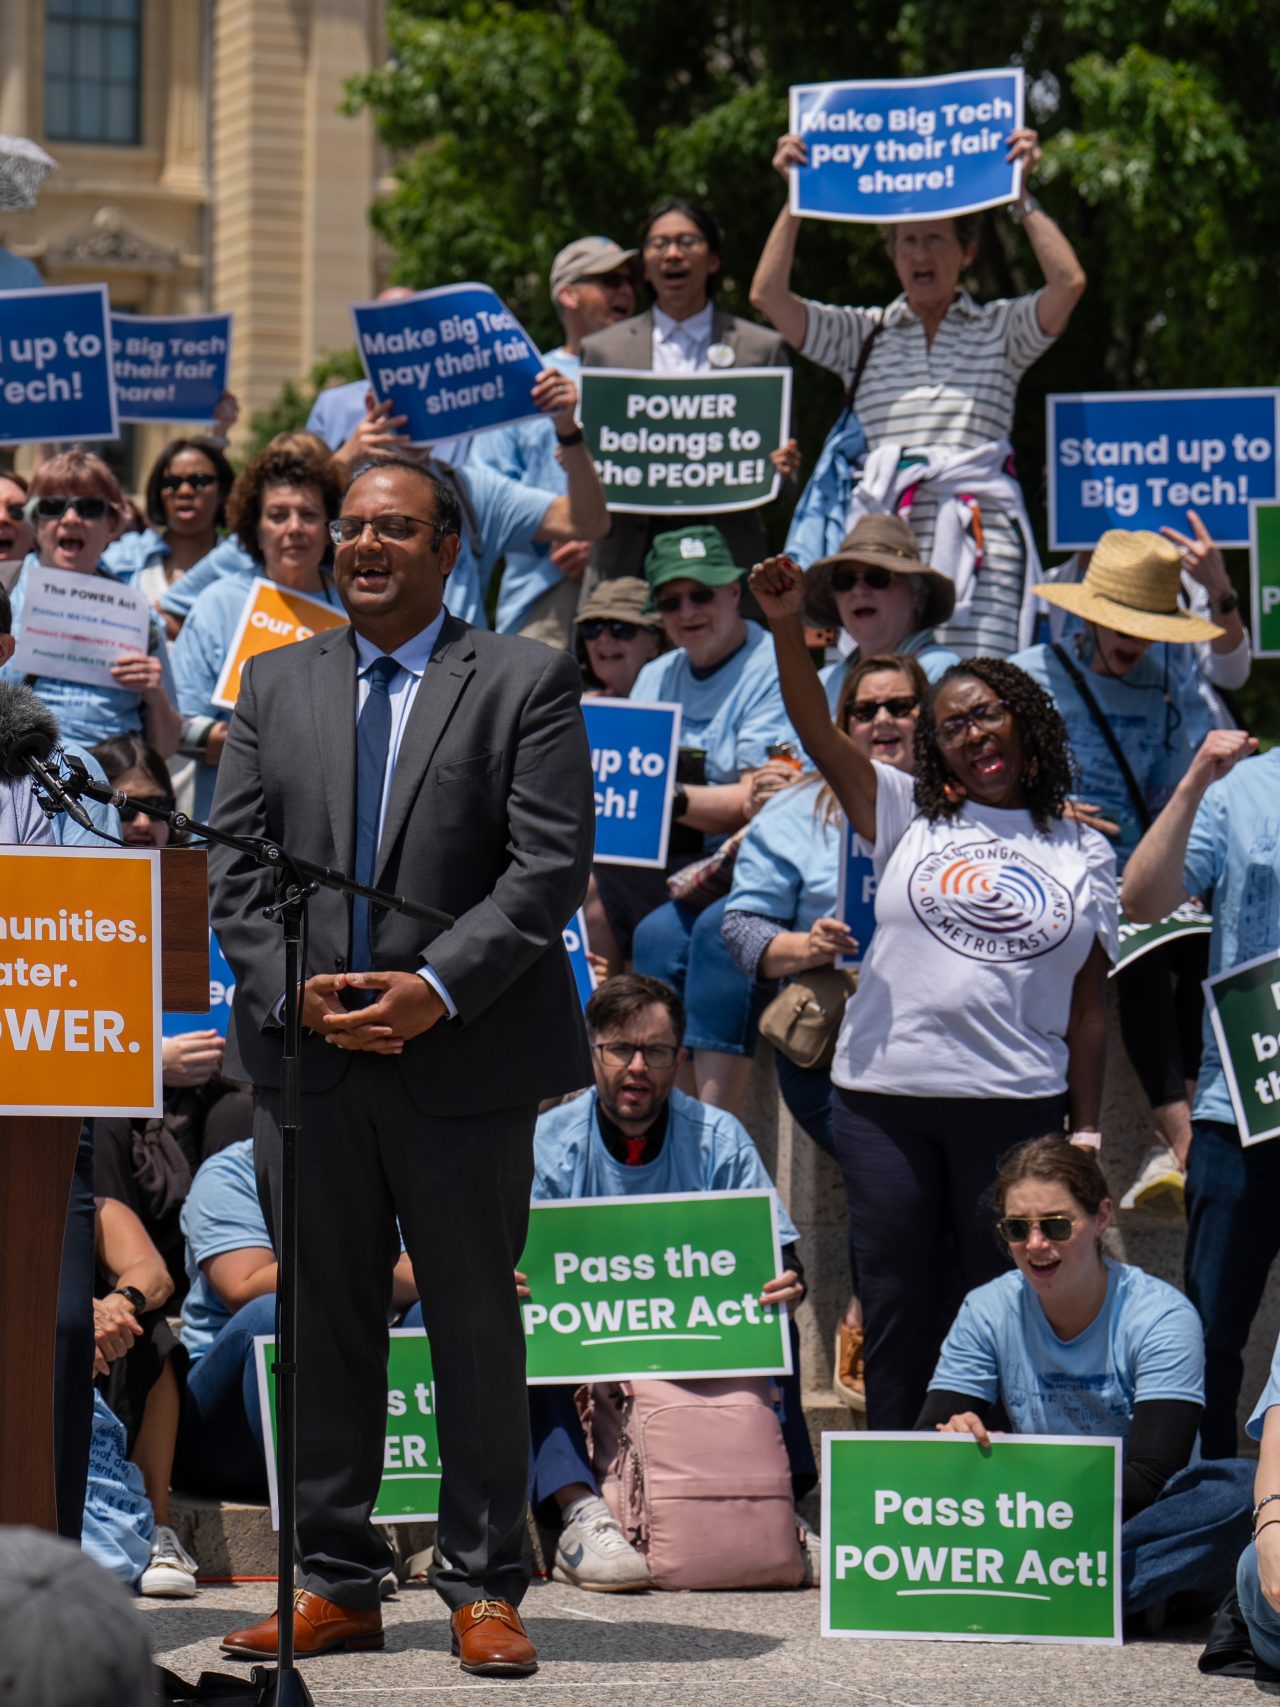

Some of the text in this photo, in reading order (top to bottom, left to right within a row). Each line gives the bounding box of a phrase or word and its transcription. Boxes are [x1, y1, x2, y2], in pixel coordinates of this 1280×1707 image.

[801, 97, 1013, 135] Make Big Tech
[811, 128, 1003, 169] pay their fair
[858, 165, 955, 194] share!
[7, 337, 58, 371] up
[65, 330, 101, 357] to
[125, 336, 165, 361] Big
[169, 335, 226, 357] Tech
[362, 326, 437, 356] Make
[439, 317, 479, 345] Big
[174, 359, 217, 379] fair
[379, 334, 529, 392] pay their fair
[425, 374, 505, 415] share!
[626, 394, 737, 420] POWER
[599, 425, 761, 461] belongs to
[1059, 434, 1271, 473] Stand up to
[647, 458, 765, 488] PEOPLE!
[1081, 475, 1249, 517] Big Tech!
[43, 583, 137, 611] The POWER Act
[250, 610, 294, 637] Our
[628, 746, 665, 777] to
[919, 847, 963, 882] UNITED
[920, 896, 1051, 955] OF METRO-EAST
[554, 1245, 736, 1285] Pass the
[523, 1297, 676, 1335] POWER
[874, 1490, 1074, 1530] Pass the
[835, 1544, 1108, 1588] POWER Act!
